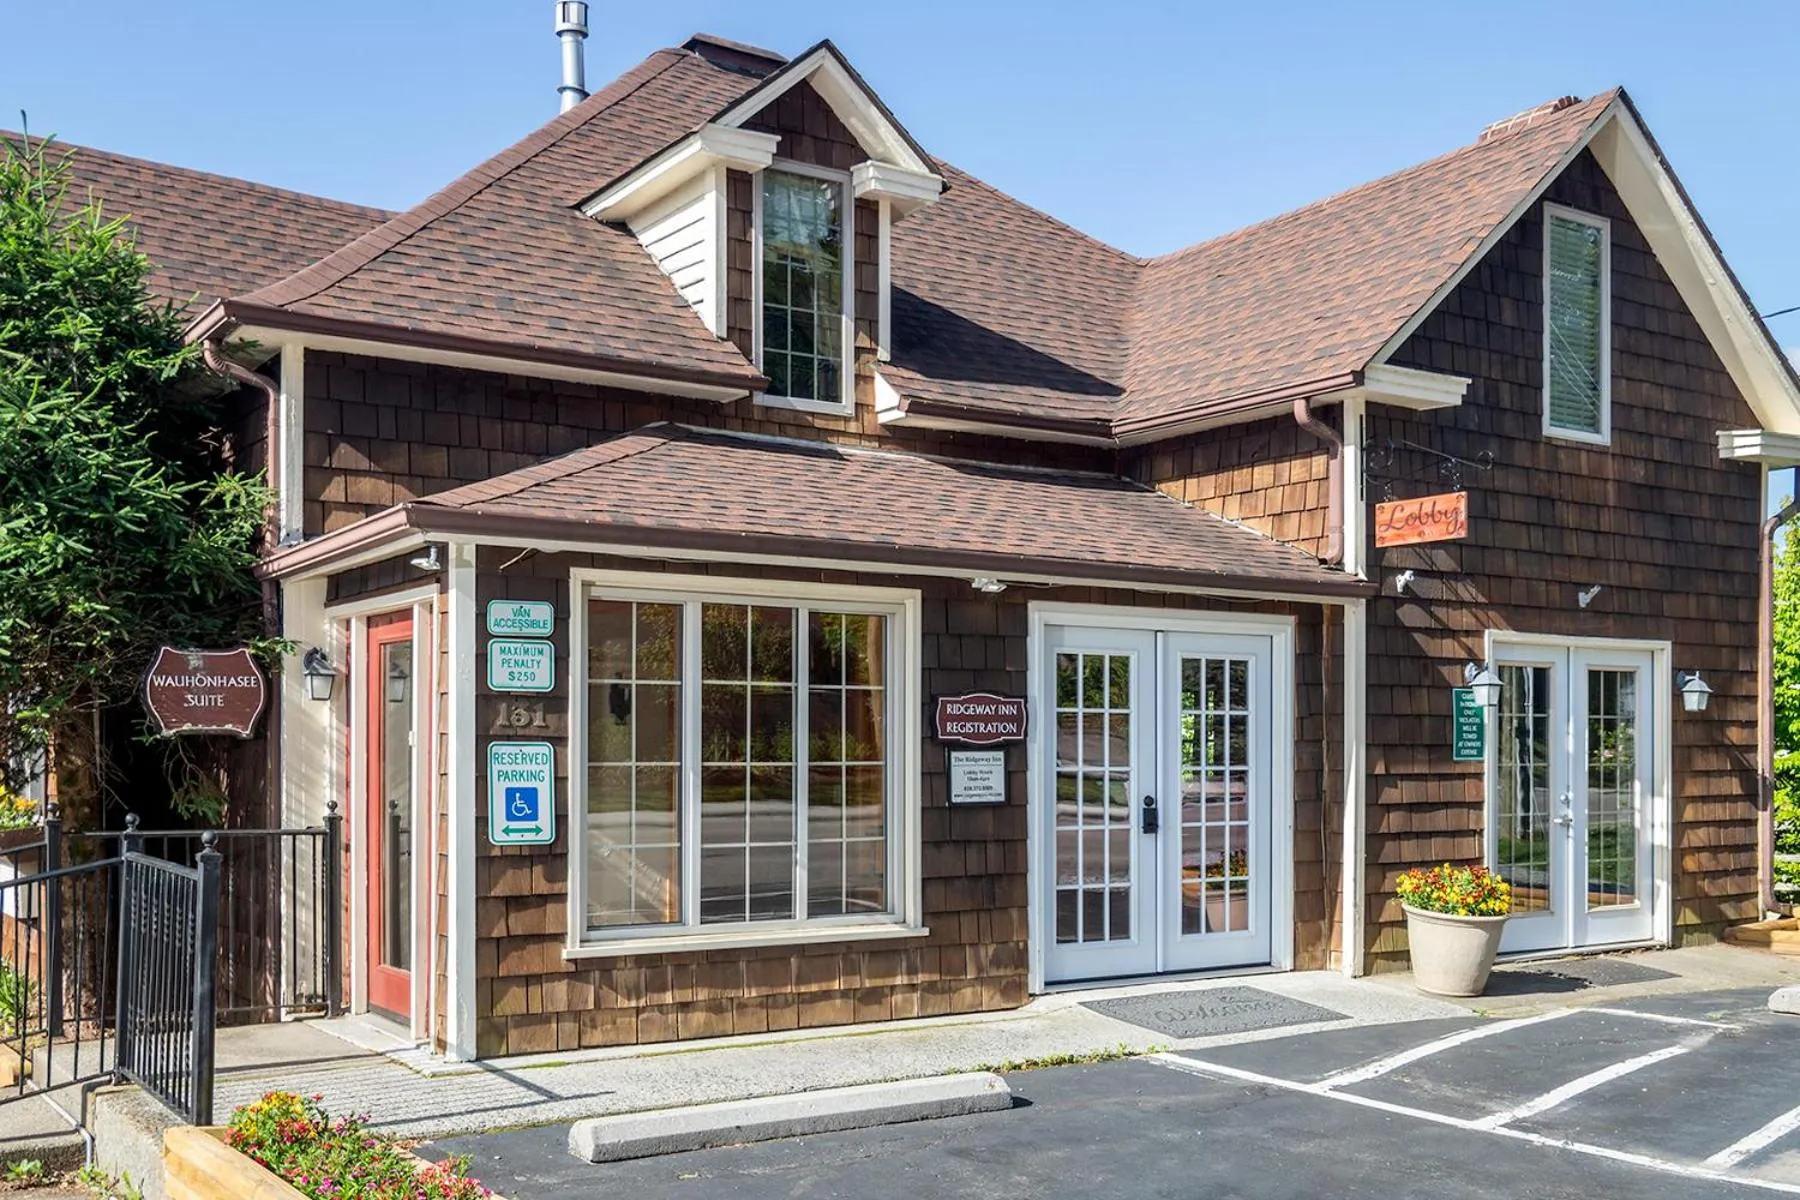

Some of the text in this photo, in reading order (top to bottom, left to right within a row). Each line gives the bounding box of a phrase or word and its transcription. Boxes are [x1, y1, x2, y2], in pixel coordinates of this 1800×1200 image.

[1379, 500, 1460, 535] Lobby
[512, 607, 531, 618] VAN
[493, 618, 549, 629] ACCESSIBLE
[500, 646, 544, 657] MAXIMUM
[501, 658, 541, 669] PENALTY
[153, 674, 258, 688] WAUHONHASEE
[184, 694, 225, 708] SUITE
[946, 703, 1017, 715] RIDGEWAY INN
[946, 722, 1017, 733] REGISTRATION
[493, 752, 549, 766] RESERVED
[497, 770, 546, 783] PARKING
